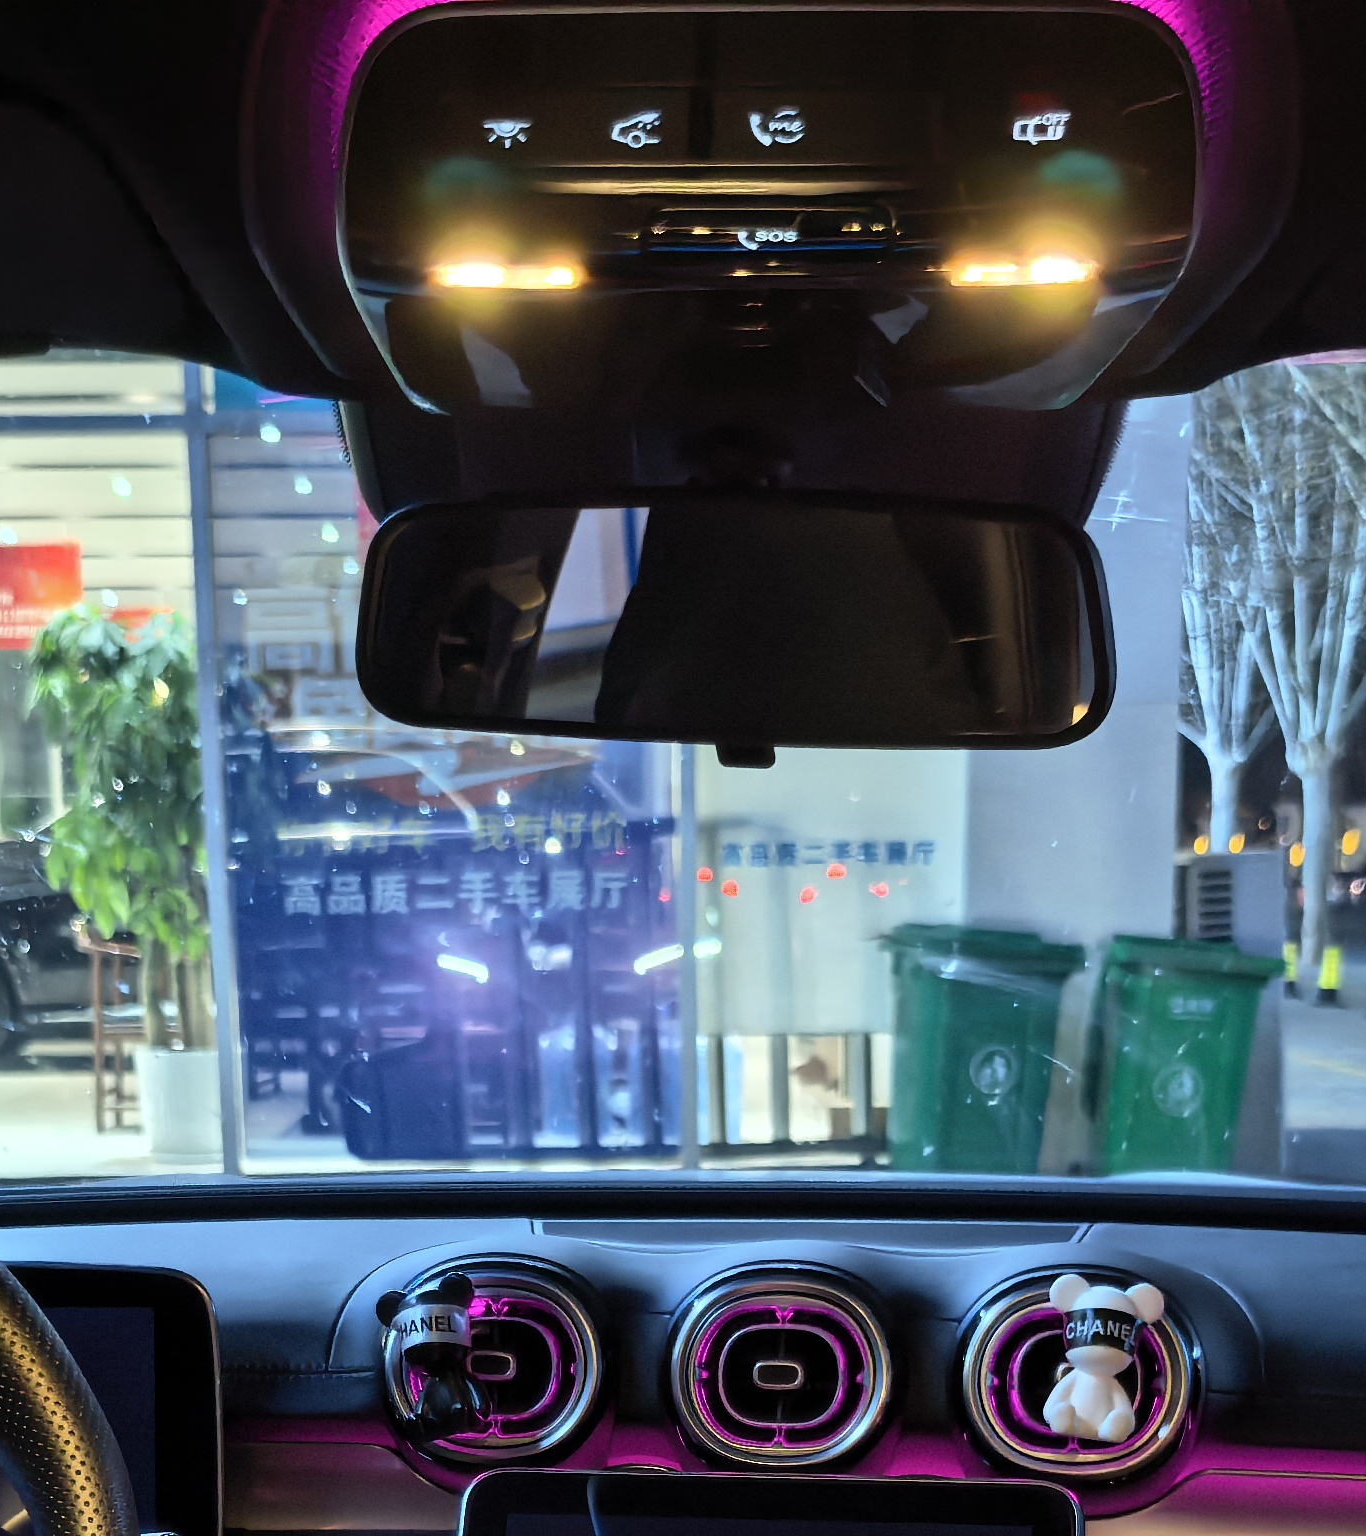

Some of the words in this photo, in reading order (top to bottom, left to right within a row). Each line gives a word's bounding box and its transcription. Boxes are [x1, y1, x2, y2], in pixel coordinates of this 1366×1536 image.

[754, 230, 799, 243] SOS
[281, 867, 628, 916] 高品质二手车展厅
[399, 1315, 457, 1337] HANEL
